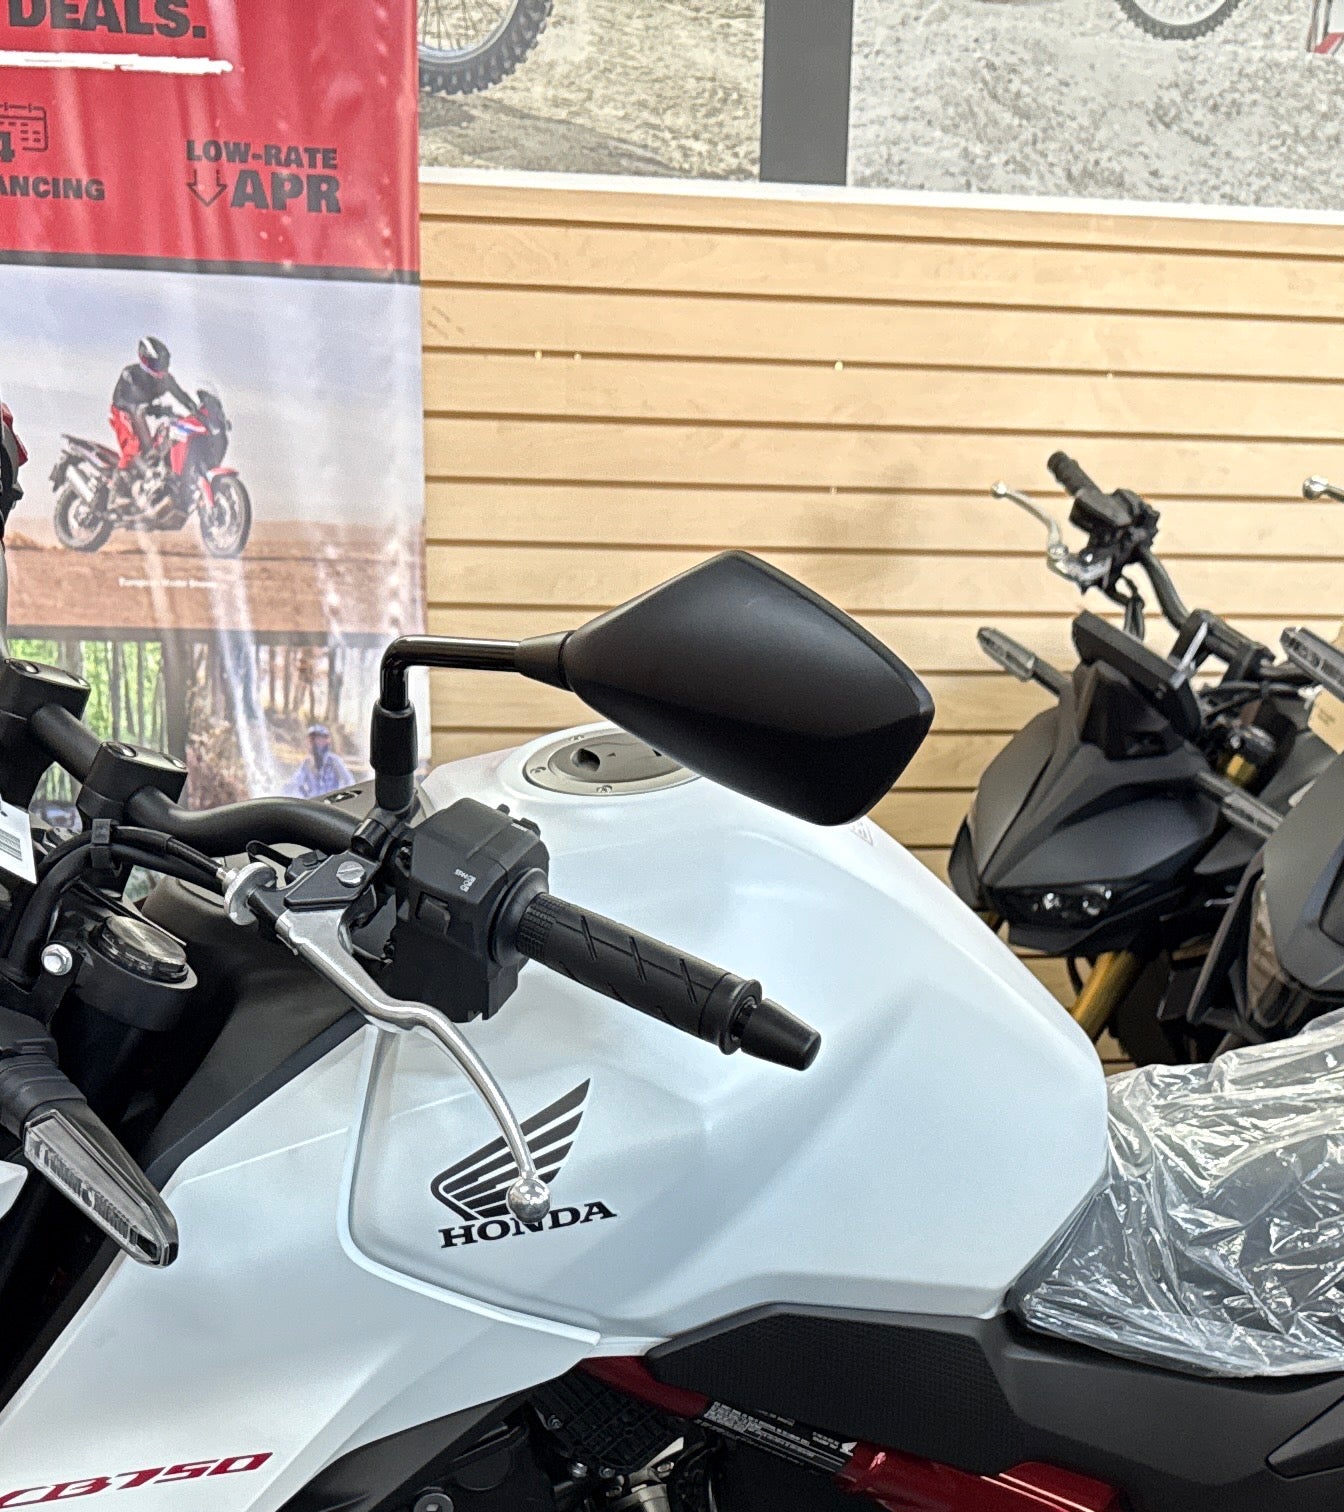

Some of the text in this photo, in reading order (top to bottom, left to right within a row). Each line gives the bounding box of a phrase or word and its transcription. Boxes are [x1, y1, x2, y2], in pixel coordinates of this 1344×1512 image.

[9, 0, 207, 38] DEALS.
[186, 139, 338, 170] LOW-RATE
[230, 168, 342, 214] APR
[439, 1200, 618, 1248] HONDA
